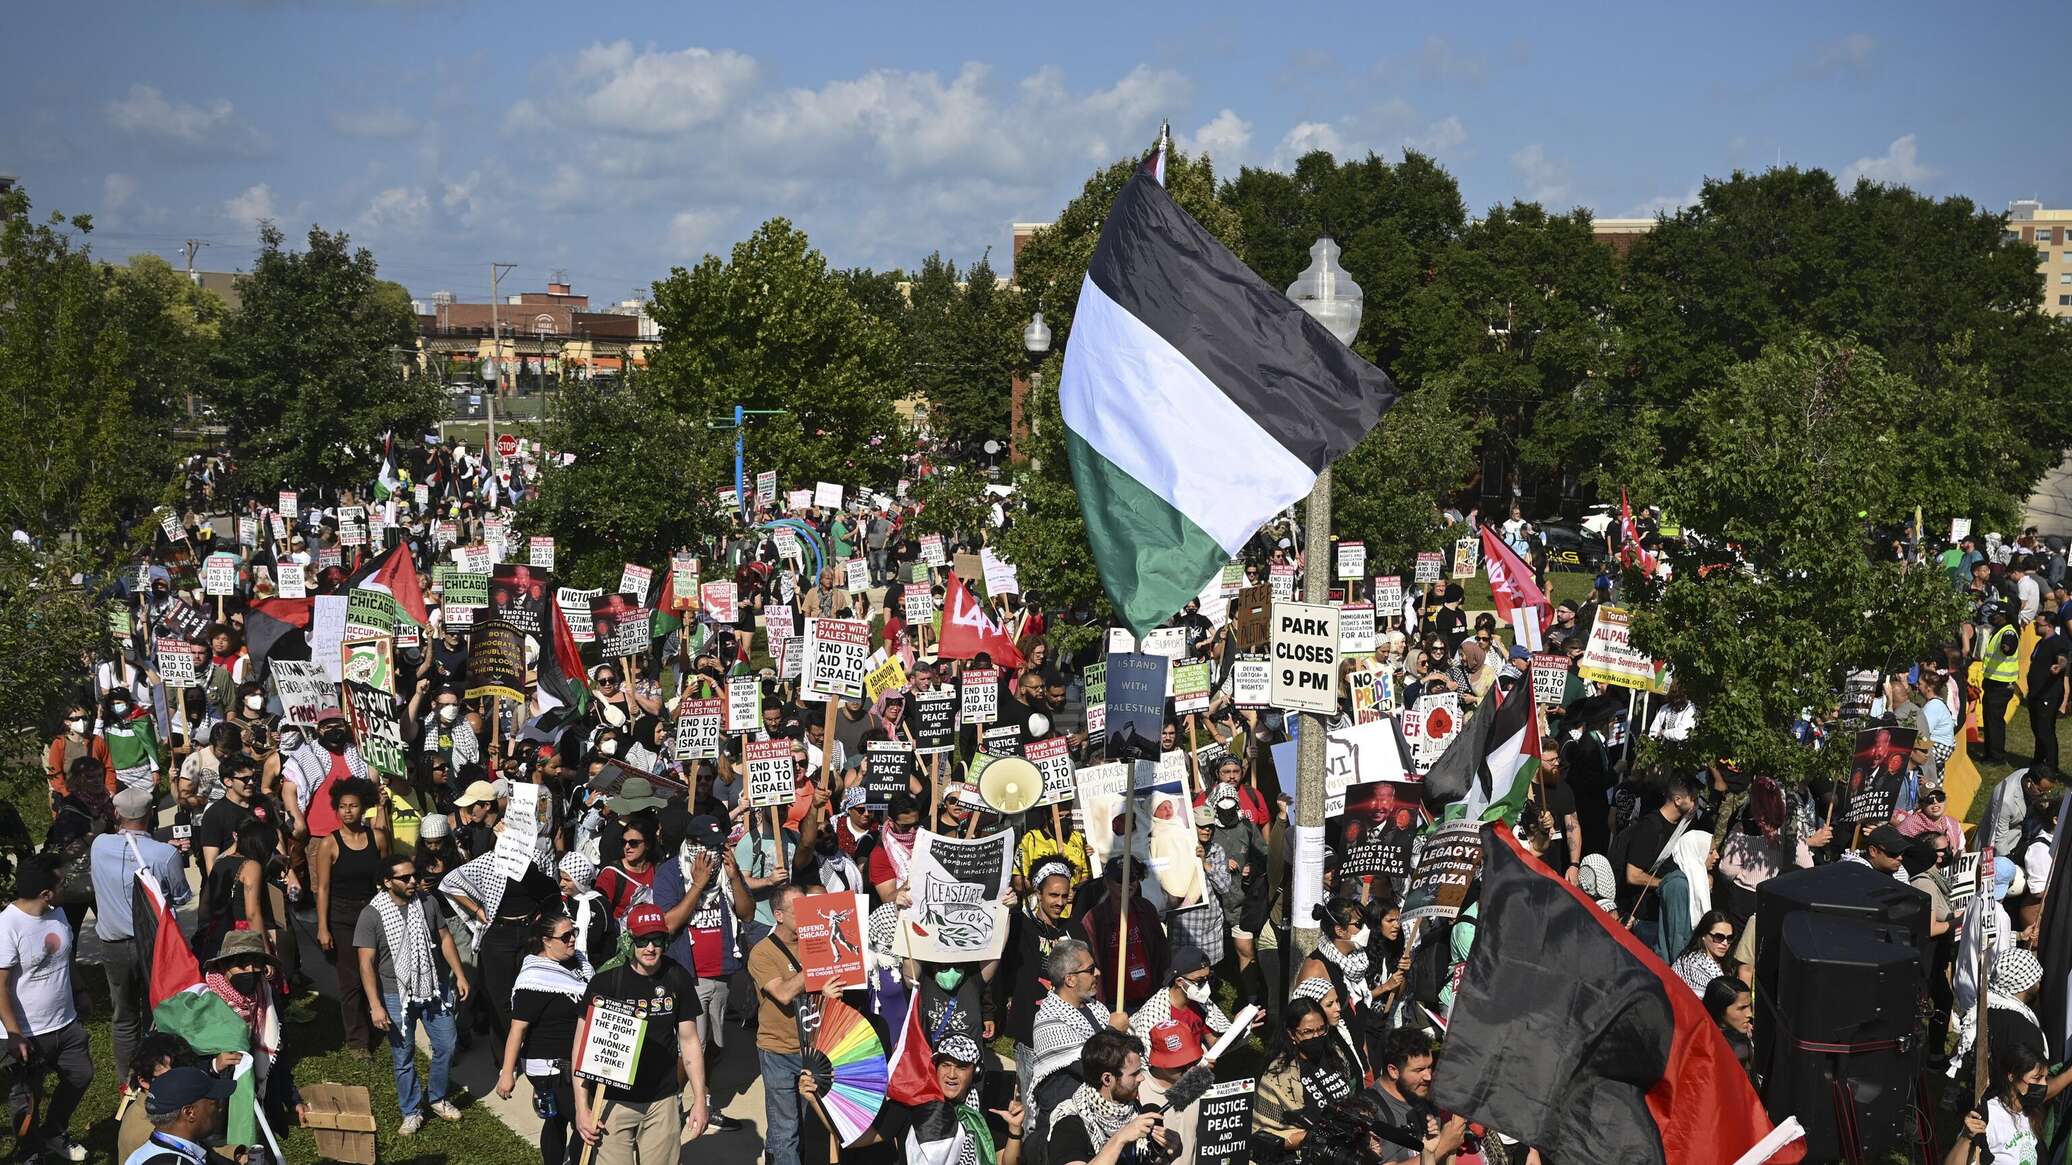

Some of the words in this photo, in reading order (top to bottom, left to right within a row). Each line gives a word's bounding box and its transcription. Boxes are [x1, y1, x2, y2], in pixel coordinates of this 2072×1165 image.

[498, 441, 515, 451] STOP
[341, 508, 363, 516] VICTORY
[444, 579, 487, 590] CHICAGO
[445, 595, 487, 604] PALESTINE
[350, 596, 395, 616] CHICAGO
[907, 610, 931, 618] ISRAEL!
[1607, 611, 1628, 622] Torah
[349, 613, 393, 632] PALESTINE
[820, 621, 846, 631] STAND
[849, 624, 868, 634] WITH
[1282, 616, 1329, 637] PARK
[819, 631, 867, 643] PALESTINE!
[1341, 631, 1353, 639] FOR
[1355, 630, 1373, 639] ALL!
[1594, 628, 1608, 640] ALL
[622, 636, 647, 646] ISRAEL!
[819, 642, 841, 654] END
[846, 646, 863, 657] U.S
[1276, 642, 1334, 664] CLOSES
[160, 654, 176, 662] END
[818, 655, 840, 666] AID
[847, 657, 862, 670] TO
[1587, 651, 1616, 664] Palestinian
[1618, 657, 1650, 672] Sovereignty
[1123, 660, 1157, 670] STAND
[162, 670, 193, 678] ISRAEL!
[816, 667, 861, 683] ISRAEL!
[869, 663, 895, 688] ABANDON
[1534, 669, 1548, 677] END
[1551, 670, 1564, 678] U.S
[962, 676, 997, 684] PALESTINE!
[1282, 670, 1294, 686] 9
[1299, 671, 1329, 690] PM
[1353, 673, 1372, 688] NO
[964, 686, 979, 695] END
[983, 686, 995, 694] U.S
[1121, 681, 1148, 691] WITH
[964, 695, 979, 704] AID
[983, 694, 996, 703] TO
[681, 707, 721, 716] PALESTINE!
[919, 702, 952, 711] JUSTICE.
[963, 703, 995, 713] ISRAEL!
[1108, 704, 1161, 716] PALESTINE
[680, 718, 699, 728] END
[702, 716, 718, 727] U.S
[736, 713, 755, 721] STRIKE!
[922, 712, 948, 721] PEACE.
[679, 728, 699, 738] AID
[702, 727, 717, 737] TO
[919, 728, 951, 736] EQUALITY!
[678, 737, 717, 749] ISRAEL!
[746, 743, 768, 752] STAND
[771, 740, 790, 749] WITH
[1026, 743, 1048, 752] STAND
[1050, 739, 1066, 748] WITH
[747, 749, 790, 759] PALESTINE!
[1027, 746, 1067, 760] PALESTINE!
[870, 754, 907, 764] JUSTICE.
[750, 762, 770, 772] END
[774, 760, 789, 770] U.S
[873, 765, 903, 774] PEACE.
[751, 773, 770, 783] AID
[775, 770, 792, 781] TO
[1054, 768, 1068, 778] TO
[752, 782, 793, 794] ISRAEL!
[870, 783, 906, 791] EQUALITY!
[1851, 792, 1889, 804] DEMOCRATS
[1428, 836, 1458, 846] GENOCIDE
[1348, 845, 1401, 854] DEMOCRATS
[1423, 846, 1480, 861] LEGACY:
[1351, 852, 1373, 860] FUND
[1342, 858, 1387, 868] GENOCIDE
[1432, 862, 1473, 870] BUTCHER
[1339, 865, 1404, 876] PALESTINIANS
[1413, 877, 1428, 889] OF
[1429, 874, 1467, 885] GAZA
[932, 883, 983, 904] CEASEFIRE
[955, 911, 983, 922] NOW
[798, 924, 825, 932] DEFEND
[800, 930, 829, 939] CHICAGO
[602, 1012, 633, 1026] DEFEND
[595, 1019, 609, 1029] THE
[613, 1024, 636, 1036] RIGHT
[608, 1032, 619, 1040] TO
[593, 1036, 630, 1053] UNIONIZE
[601, 1048, 618, 1058] AND
[594, 1055, 625, 1069] STRIKE!
[1203, 1098, 1248, 1116] JUSTICE.
[1207, 1116, 1243, 1131] PEACE.
[1219, 1132, 1232, 1141] AND
[1201, 1141, 1246, 1156] EQUALITY!
